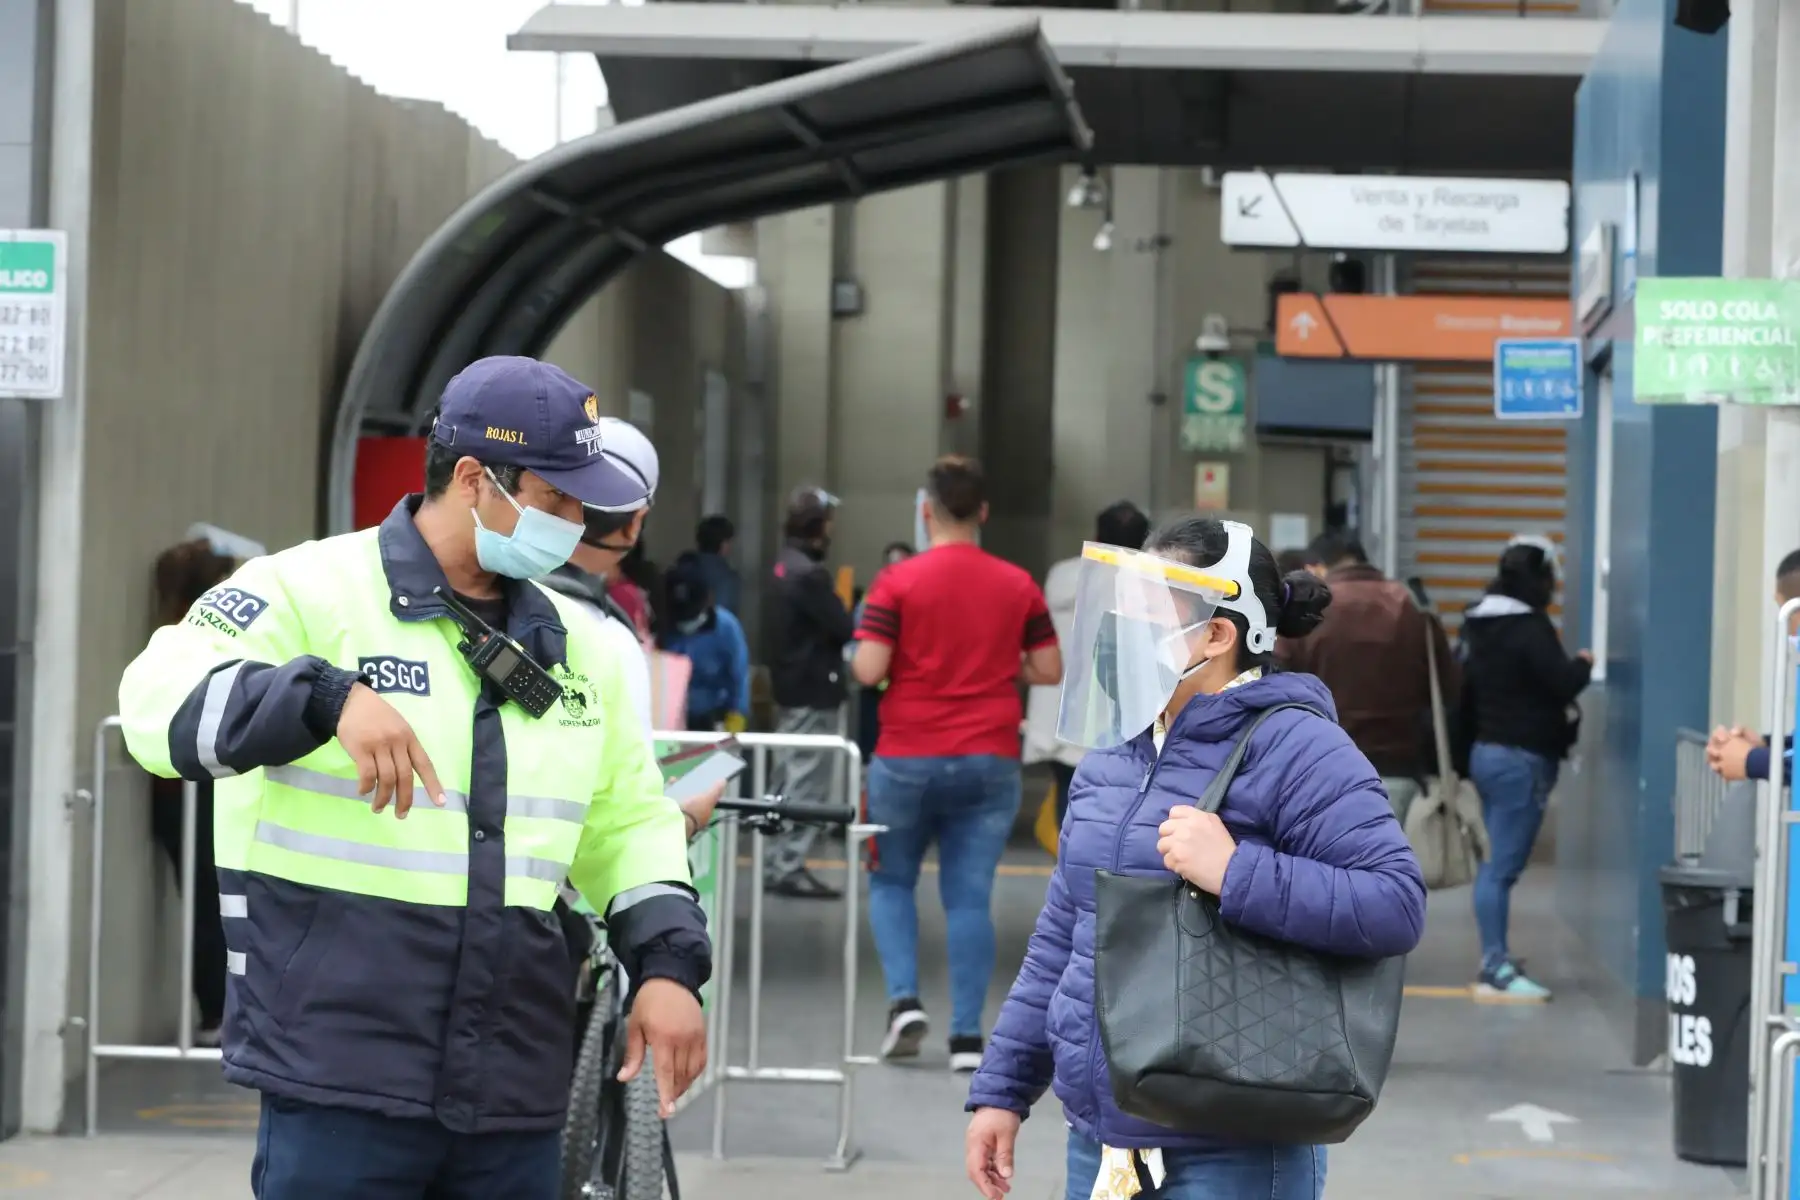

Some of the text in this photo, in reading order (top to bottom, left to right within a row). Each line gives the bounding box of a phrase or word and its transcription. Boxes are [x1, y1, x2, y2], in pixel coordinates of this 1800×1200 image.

[1351, 185, 1521, 213] Venta y Recarga
[1378, 213, 1490, 237] de Tarjetas
[1660, 300, 1778, 322] SOLO COLA
[1643, 325, 1797, 346] PREFERENCIAL
[1195, 361, 1236, 412] S
[485, 426, 518, 443] ROJAS
[362, 660, 426, 692] GSGC
